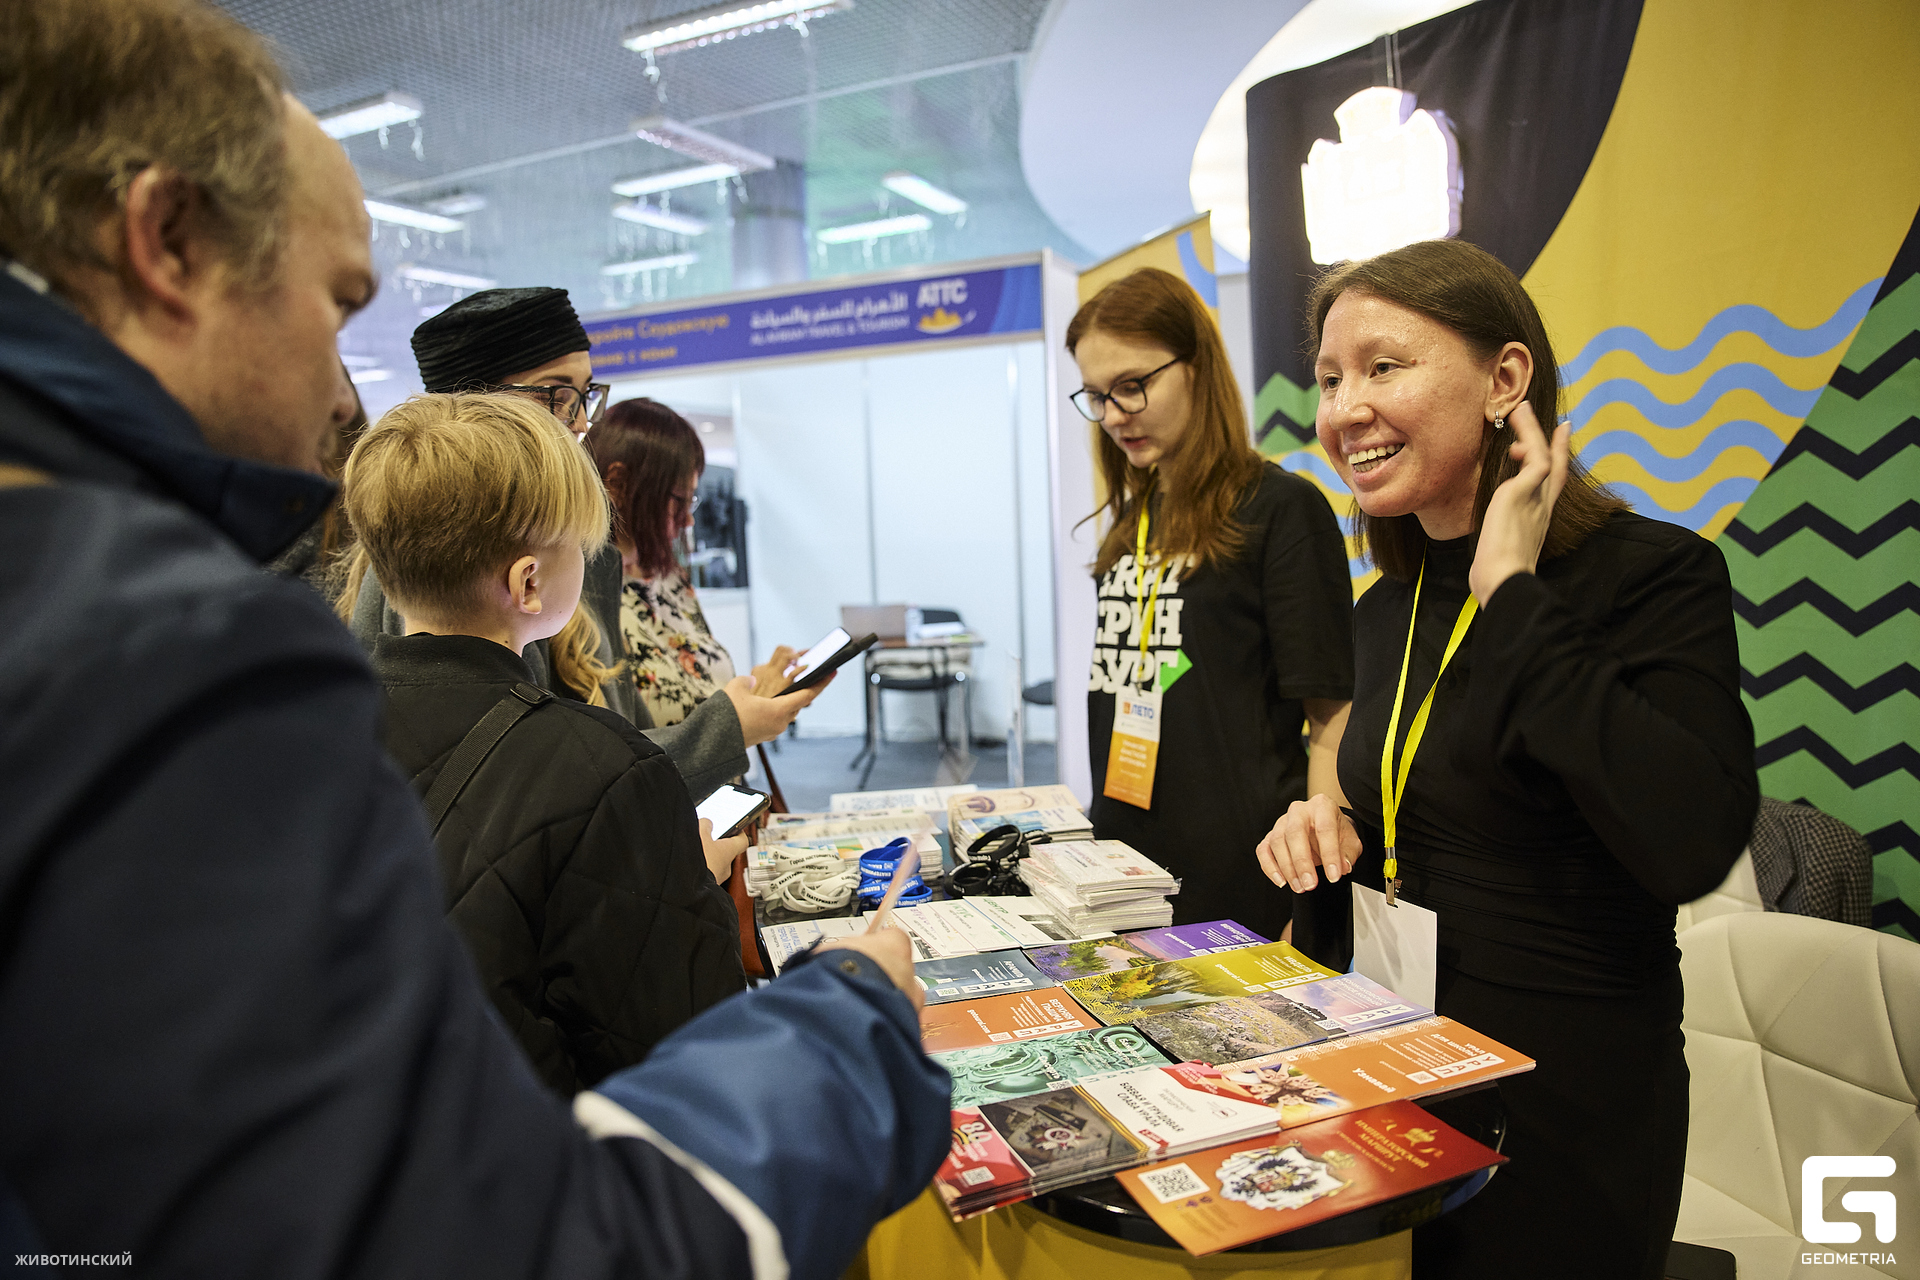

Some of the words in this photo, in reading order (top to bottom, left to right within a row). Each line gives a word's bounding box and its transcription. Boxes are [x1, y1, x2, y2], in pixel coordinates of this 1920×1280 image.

[916, 279, 968, 308] ATTC
[1131, 704, 1154, 719] ЛЕТО
[1215, 963, 1249, 985] gotoural.com
[966, 1009, 991, 1033] gotoural.com
[1346, 1006, 1407, 1022] УРАЛ
[1019, 1021, 1079, 1036] УРАЛ
[1437, 1055, 1497, 1074] УРАЛ
[1352, 1067, 1397, 1093] Узнавай
[959, 1121, 993, 1143] 80
